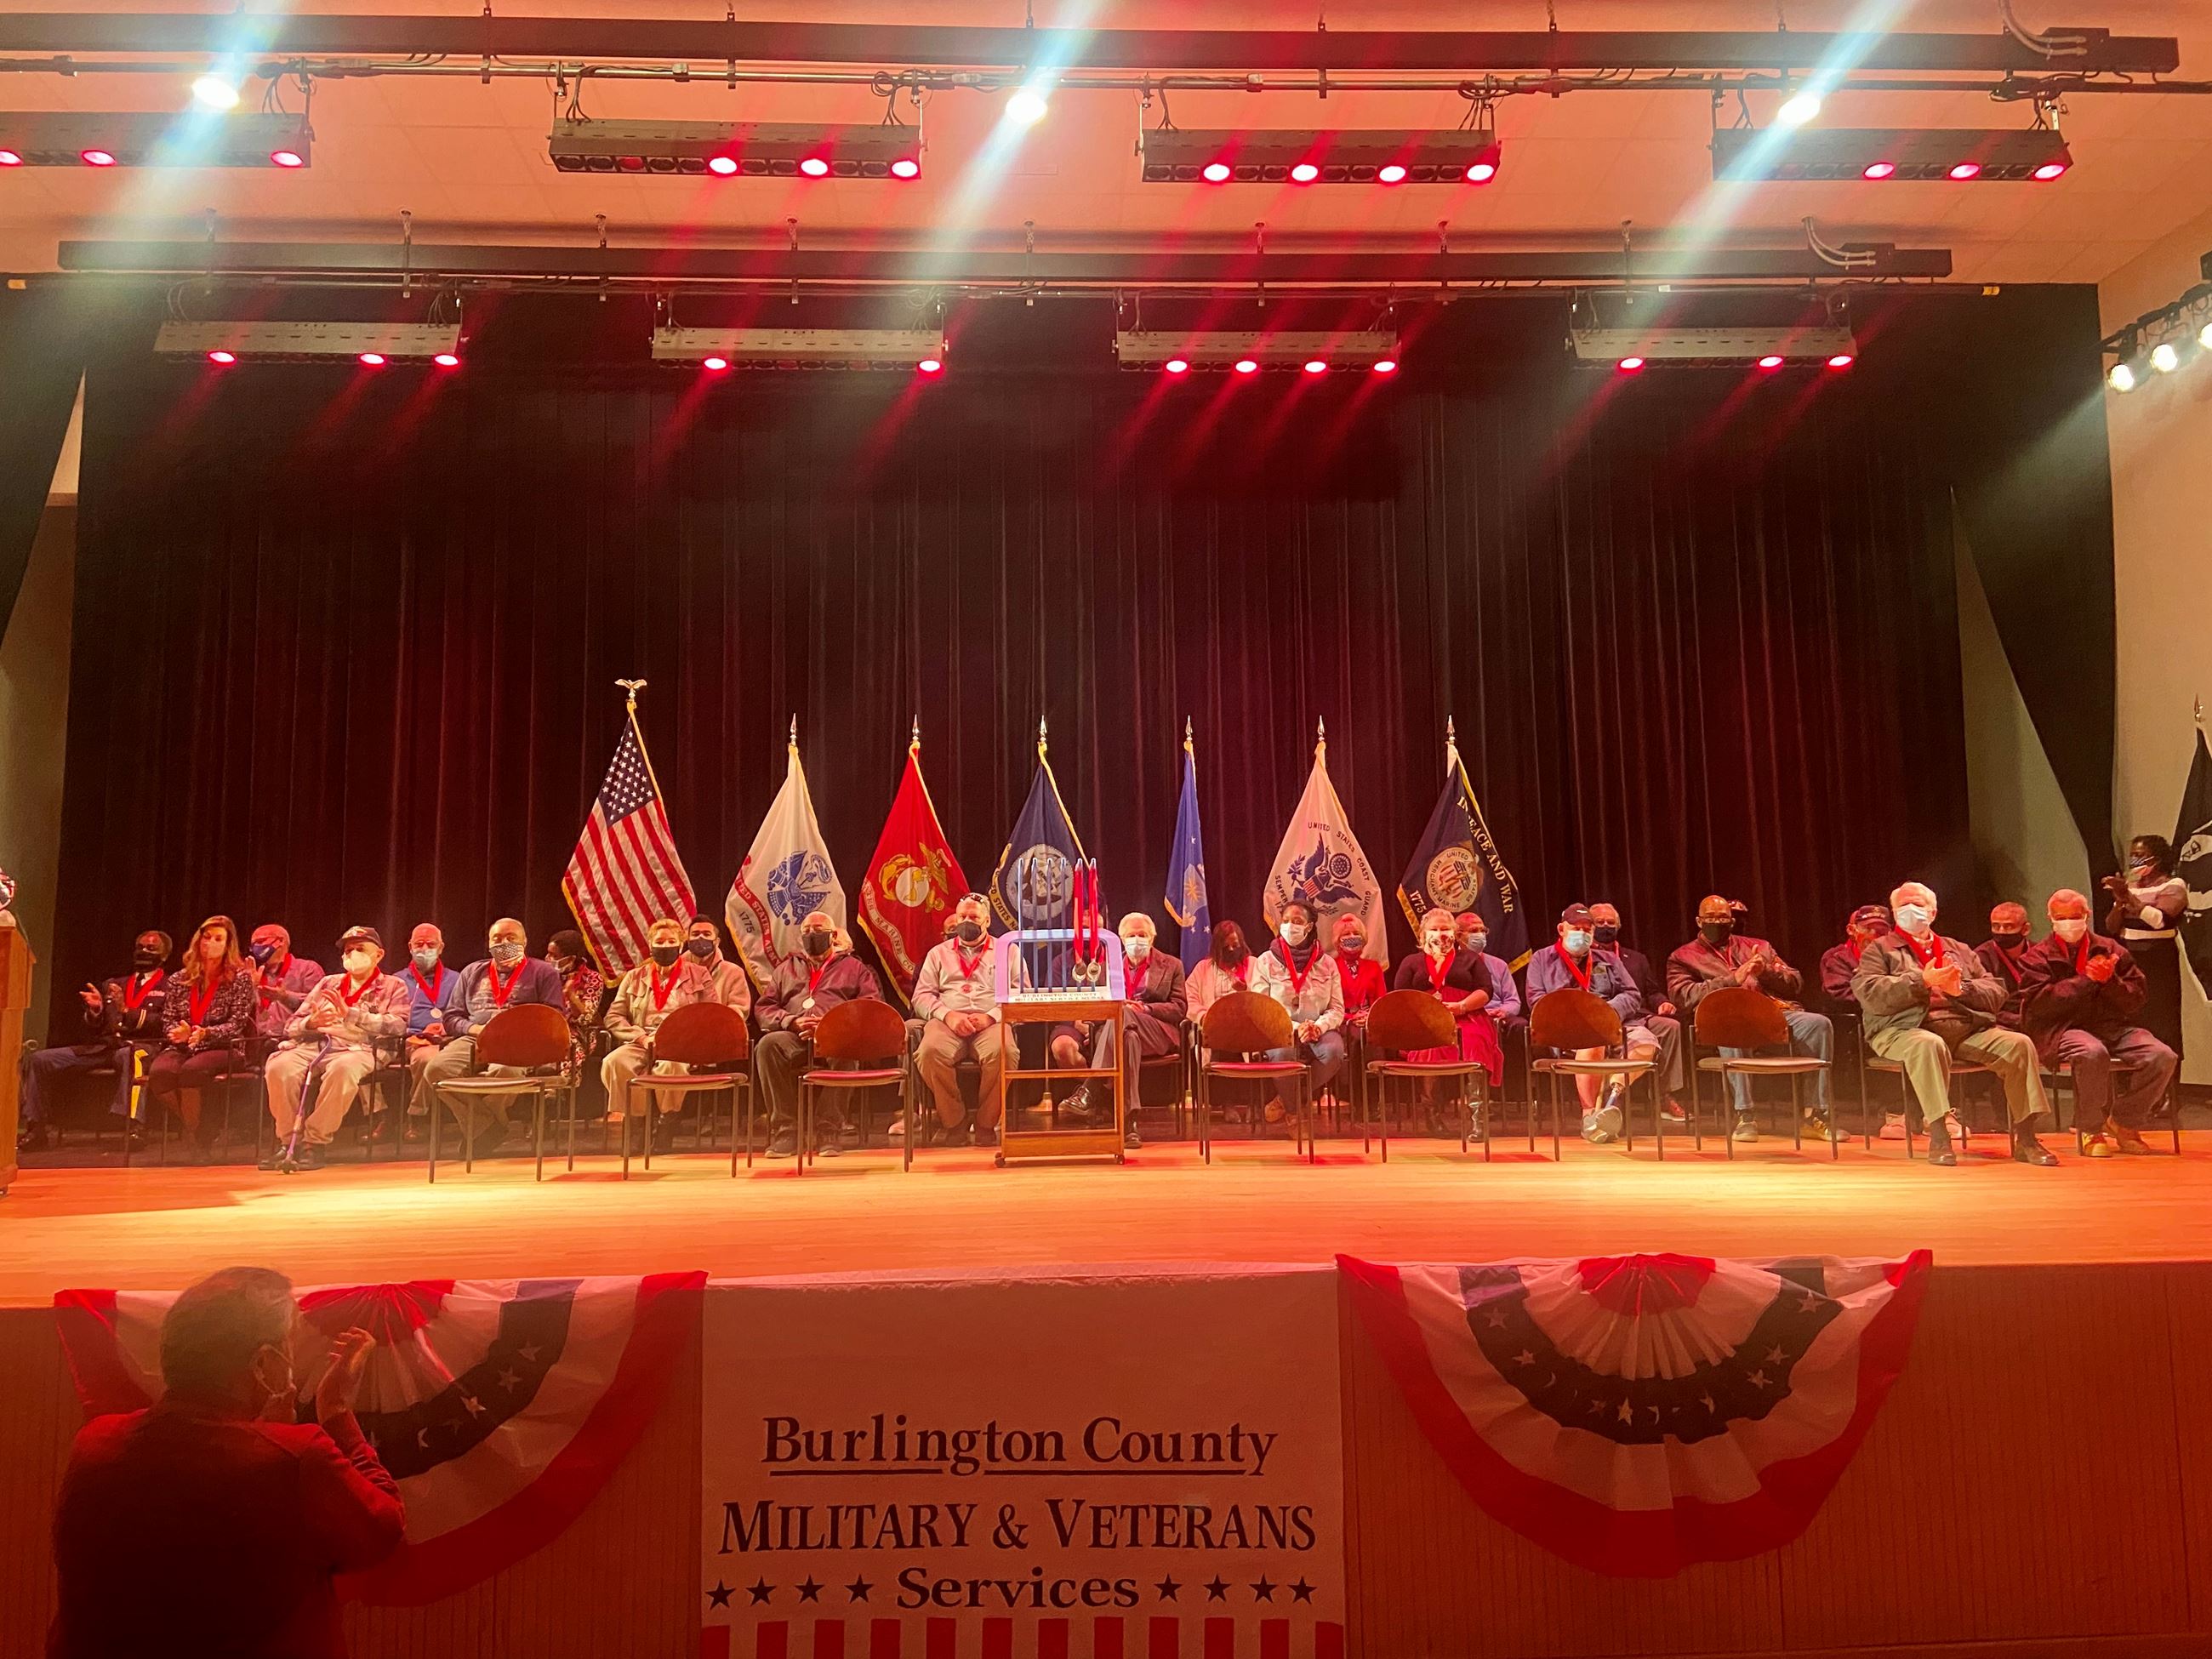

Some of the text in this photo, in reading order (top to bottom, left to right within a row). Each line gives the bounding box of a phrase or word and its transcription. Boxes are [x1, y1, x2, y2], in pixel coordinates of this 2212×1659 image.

[1308, 822, 1371, 916] UNITED STATES COAST GUARD
[1446, 852, 1469, 860] UNITED
[1468, 814, 1491, 851] EACE
[1487, 854, 1506, 881] AND
[1500, 883, 1514, 914] WAR
[1275, 875, 1288, 904] SEMPER
[1410, 890, 1427, 913] 1775
[738, 911, 755, 933] 1775
[752, 899, 770, 935] STATES
[994, 898, 1011, 921] STATES
[875, 917, 903, 955] MARINE
[761, 1413, 1279, 1477] Burlington County
[717, 1498, 1316, 1554] MILITARY & VETERANS
[897, 1566, 1139, 1609] Services
